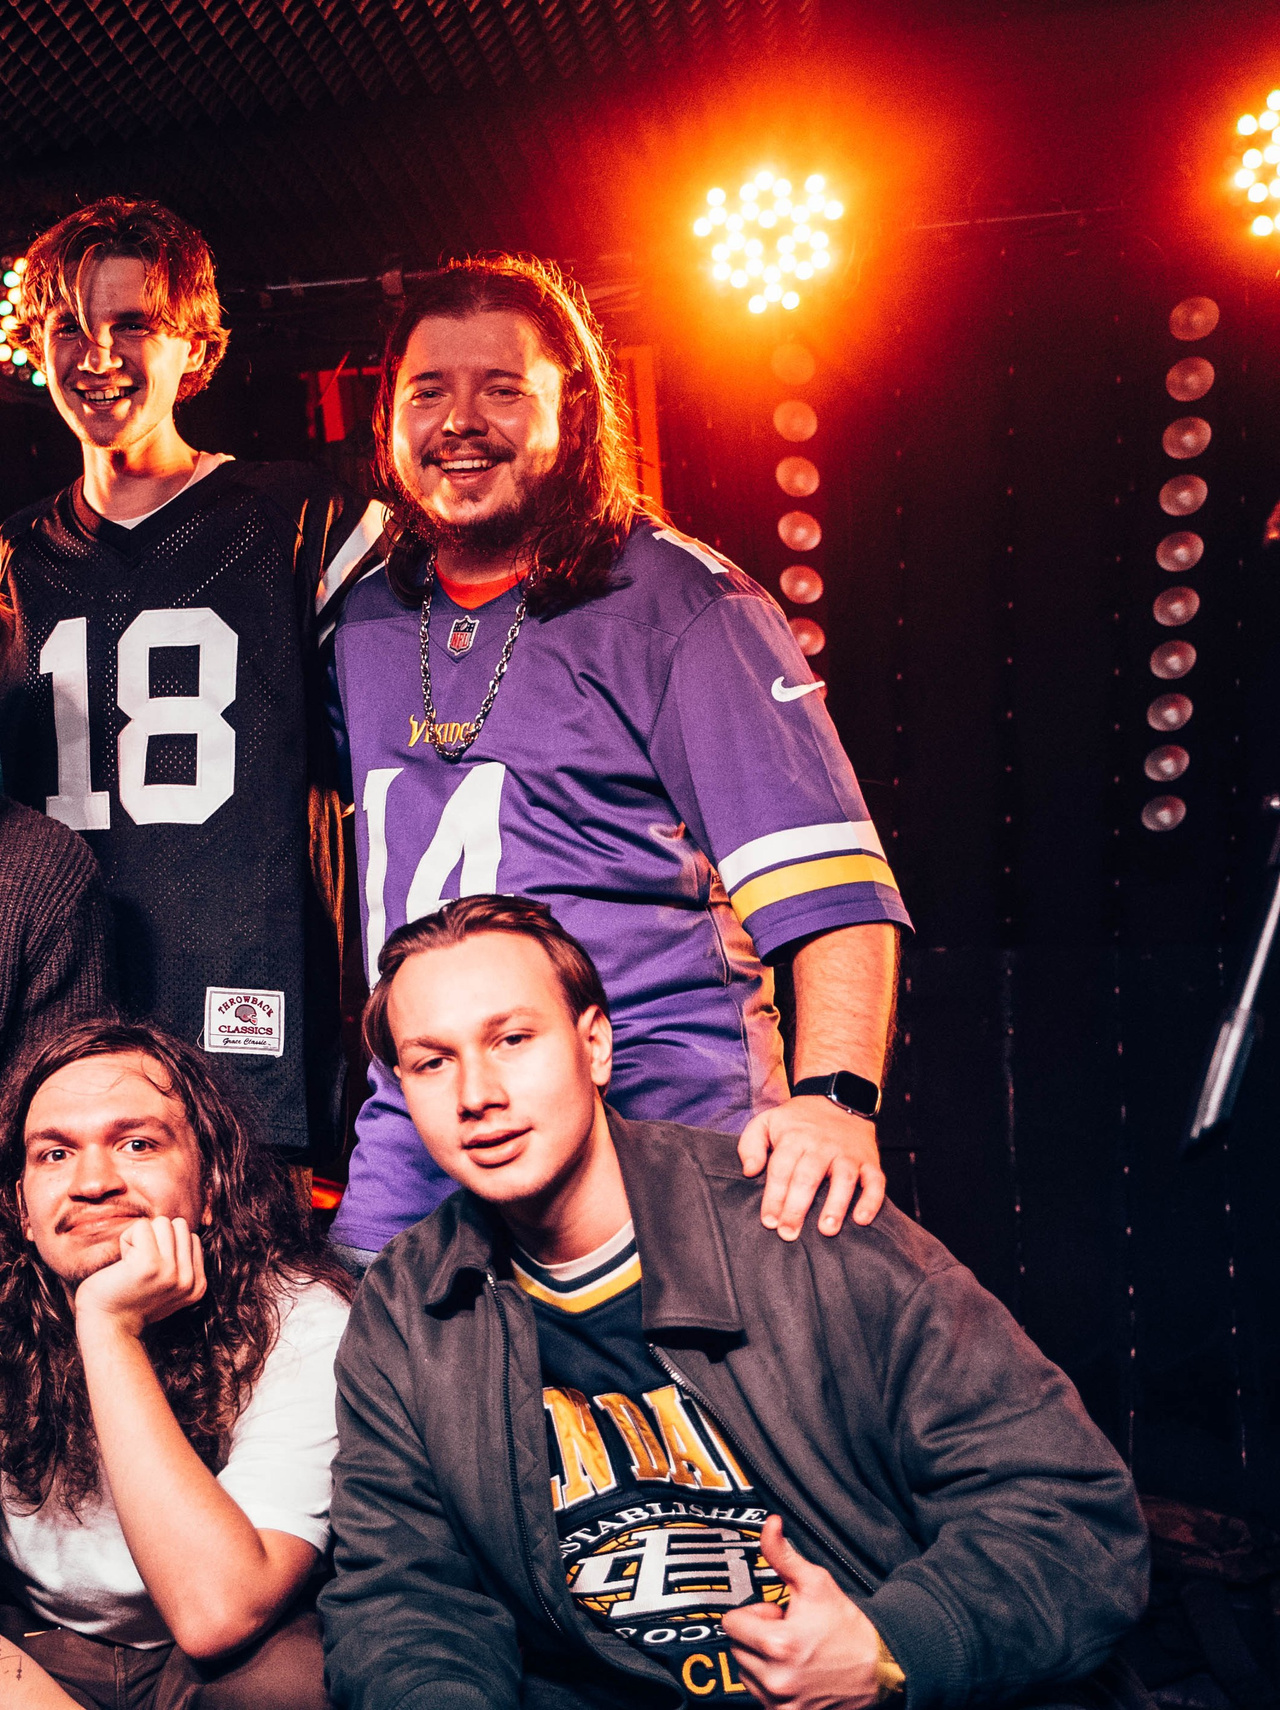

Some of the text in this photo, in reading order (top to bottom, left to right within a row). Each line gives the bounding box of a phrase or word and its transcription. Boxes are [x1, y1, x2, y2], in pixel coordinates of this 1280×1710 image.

[451, 633, 470, 648] NFL
[39, 607, 238, 831] 18
[408, 709, 478, 747] VIKING
[363, 762, 514, 995] 14
[217, 996, 274, 1018] THROWBACK
[218, 1025, 273, 1036] CLASSICS
[560, 1501, 769, 1560] STABLISHE
[681, 1651, 748, 1696] CL
